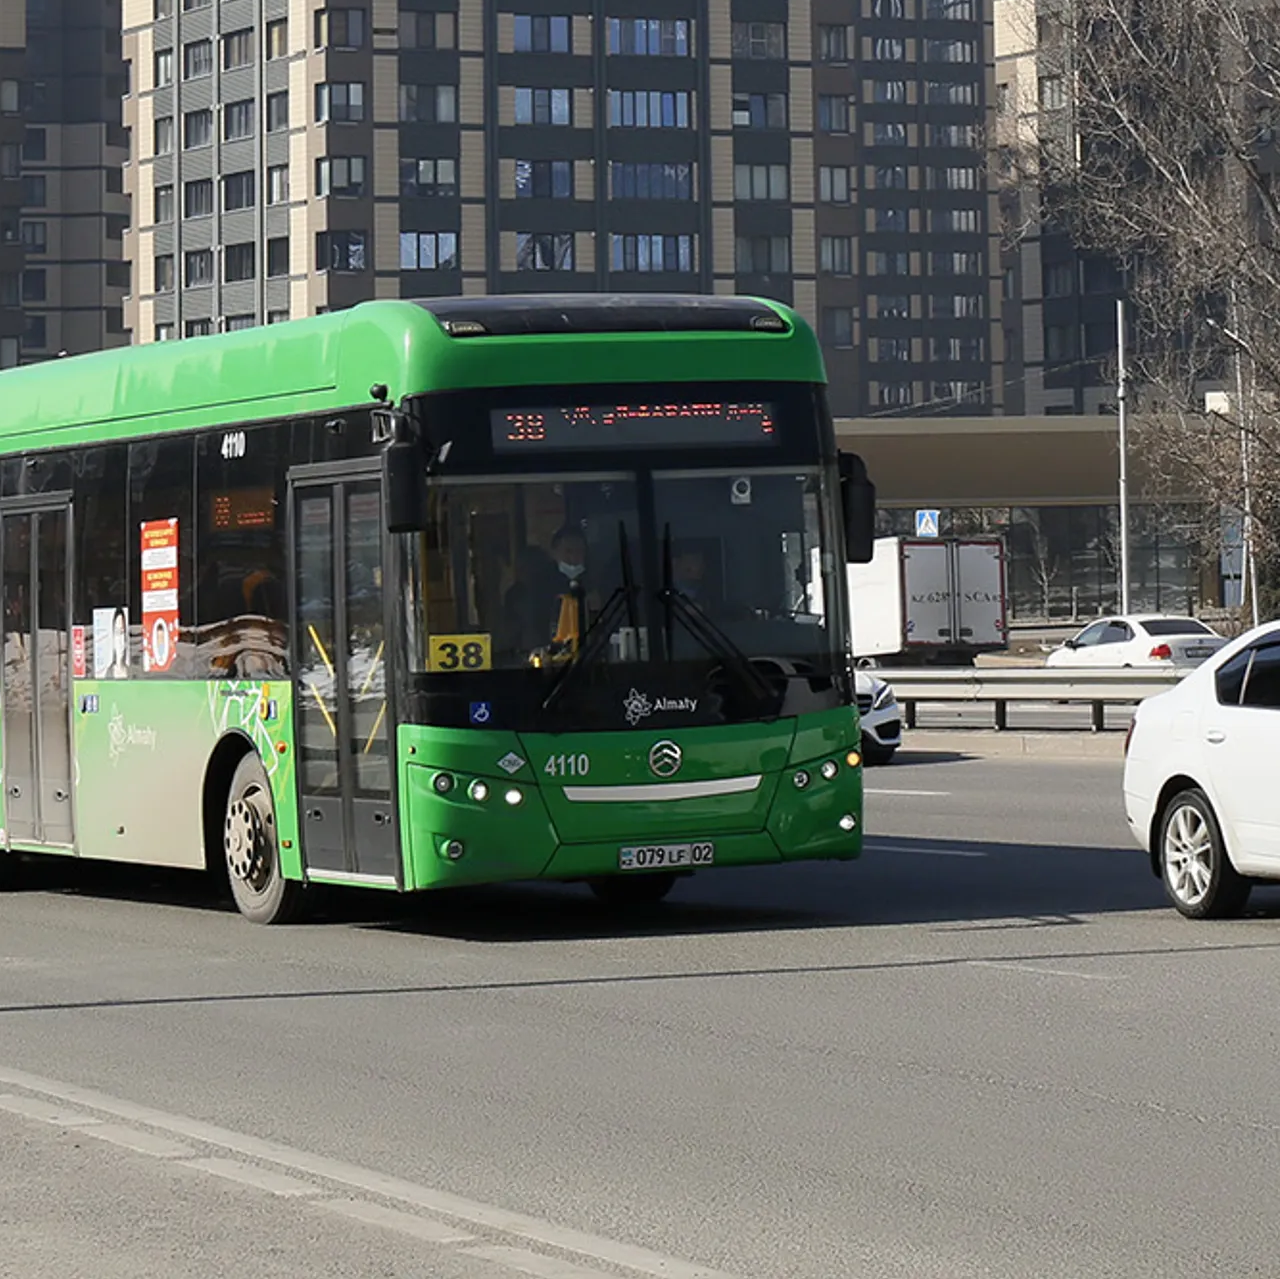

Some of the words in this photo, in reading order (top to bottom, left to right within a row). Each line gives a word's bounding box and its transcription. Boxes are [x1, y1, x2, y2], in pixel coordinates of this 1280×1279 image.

[505, 413, 544, 441] 38
[221, 430, 246, 459] 4110
[438, 642, 484, 669] 38
[653, 696, 698, 713] Almaty
[543, 753, 590, 777] 4110
[636, 847, 665, 866] 079
[668, 849, 686, 864] LF
[692, 844, 713, 862] 02
